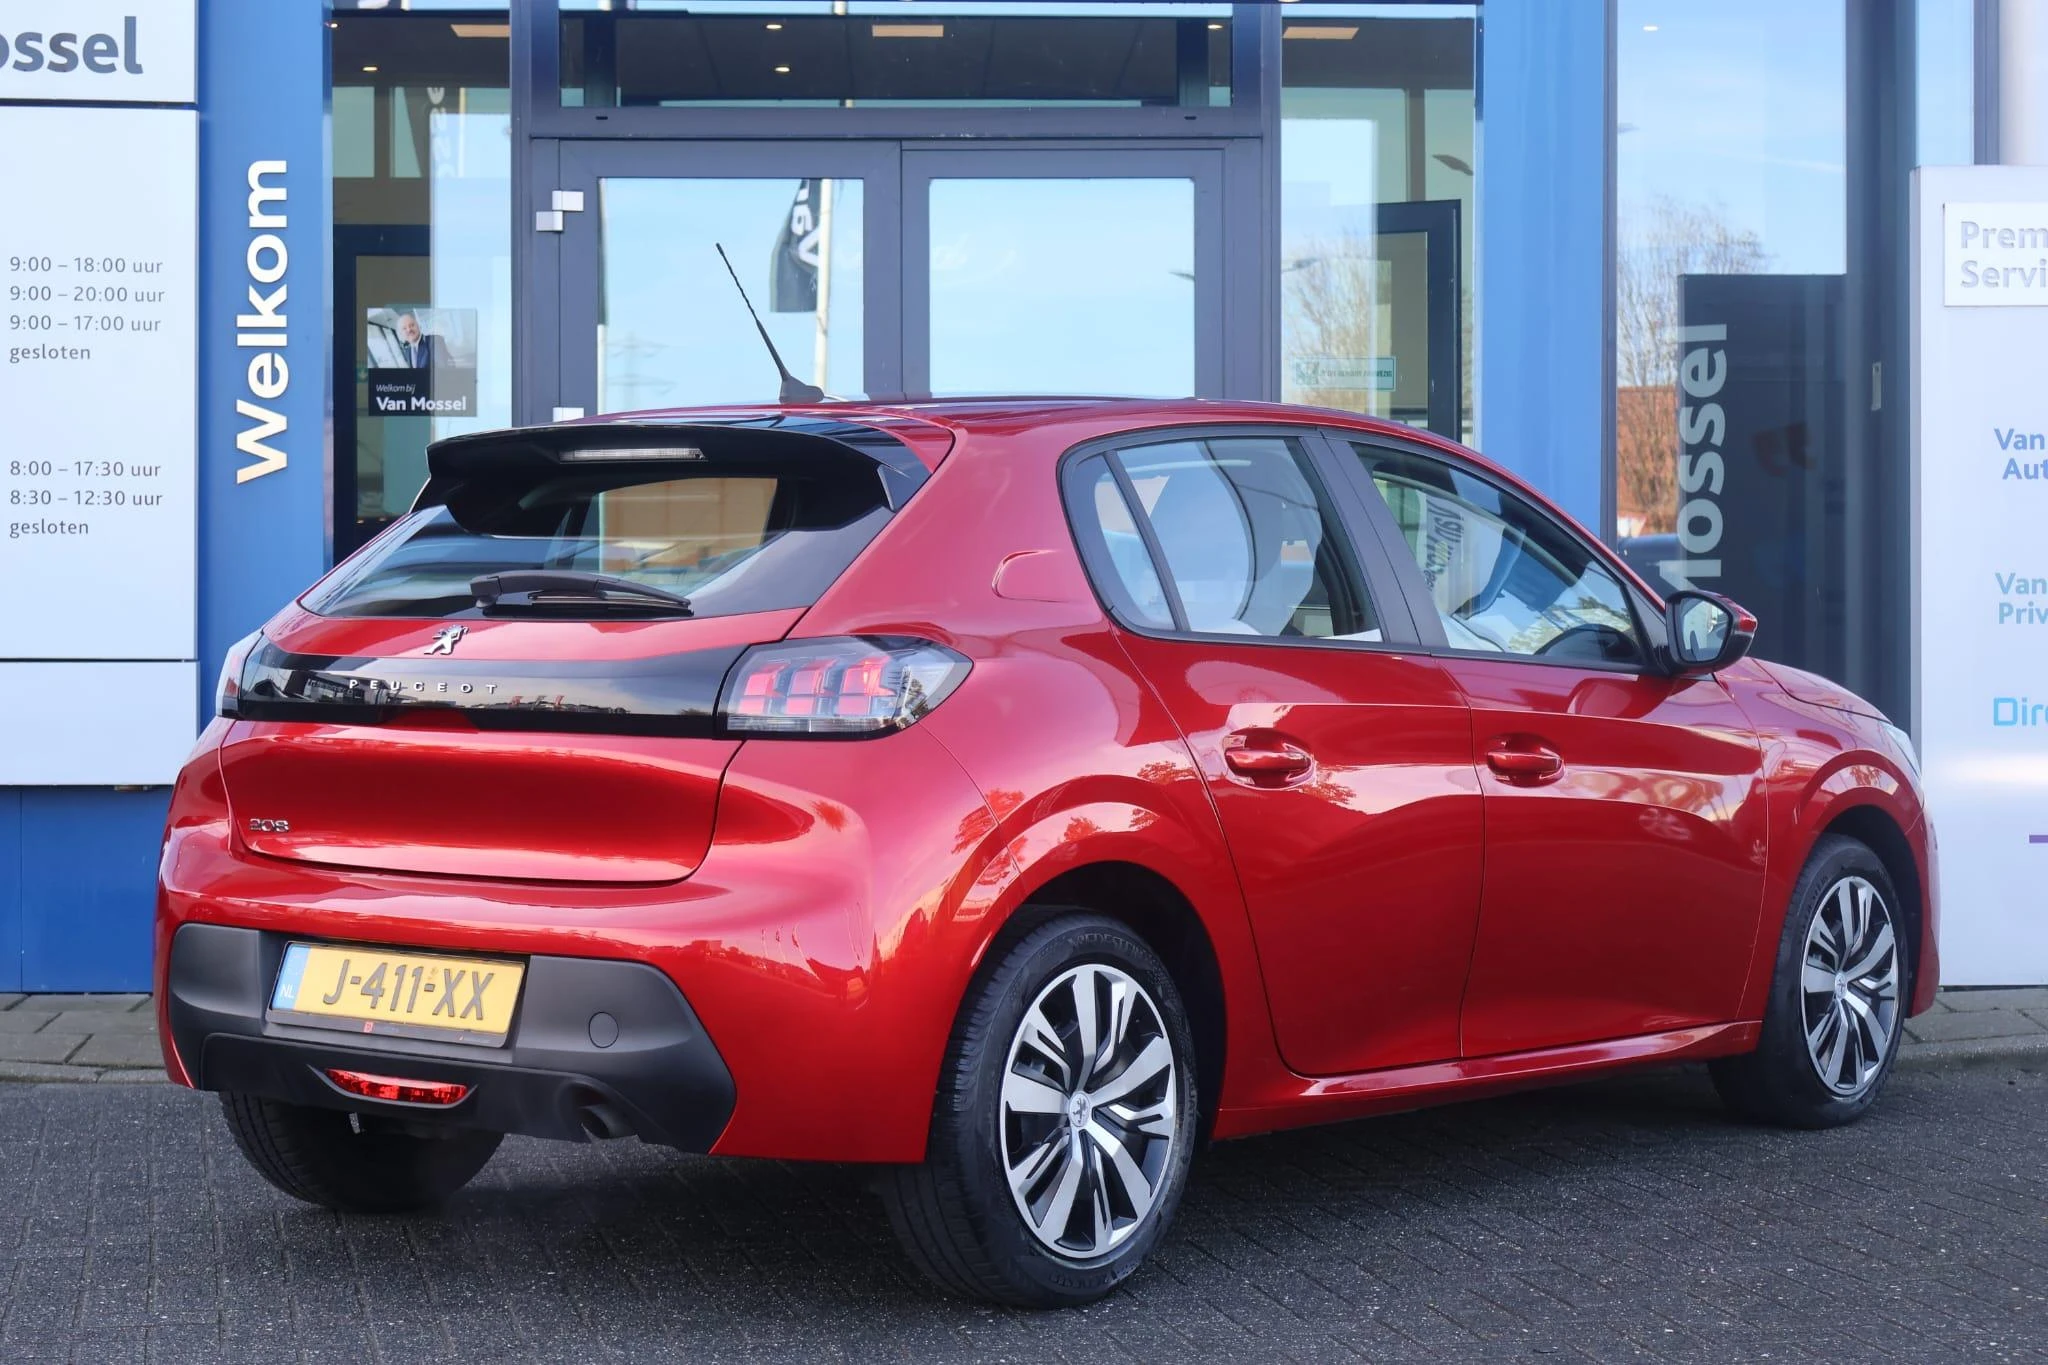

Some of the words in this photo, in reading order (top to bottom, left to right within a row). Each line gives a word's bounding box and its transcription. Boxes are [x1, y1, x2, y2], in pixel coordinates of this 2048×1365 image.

[0, 16, 143, 74] ssel
[1961, 221, 2048, 249] Prem
[10, 256, 52, 272] 9:00
[74, 257, 126, 273] 18:00
[133, 261, 163, 273] uur
[1961, 258, 2047, 288] Servi
[10, 286, 52, 301] 9:00
[73, 286, 128, 302] 20:00
[134, 291, 165, 302] uur
[10, 315, 52, 330] 9:00
[74, 315, 125, 331] 17:00
[131, 319, 161, 331] uur
[236, 160, 289, 484] Welkom
[9, 343, 91, 364] gesloten
[376, 384, 405, 392] Welkom
[376, 396, 406, 411] Van
[411, 396, 466, 410] Mossel
[1993, 427, 2045, 450] Van
[10, 460, 52, 476] 8:00
[74, 461, 125, 477] 17:30
[131, 465, 161, 477] uur
[10, 489, 52, 505] 8:30
[74, 490, 126, 506] 12:30
[132, 494, 163, 506] uur
[9, 518, 89, 539] gesloten
[1994, 572, 2047, 595] Van
[349, 679, 498, 695] PEUGEOT
[1993, 697, 2048, 726] Dir
[249, 817, 290, 833] 208
[280, 983, 295, 999] NL
[322, 958, 495, 1021] J-411-XX
